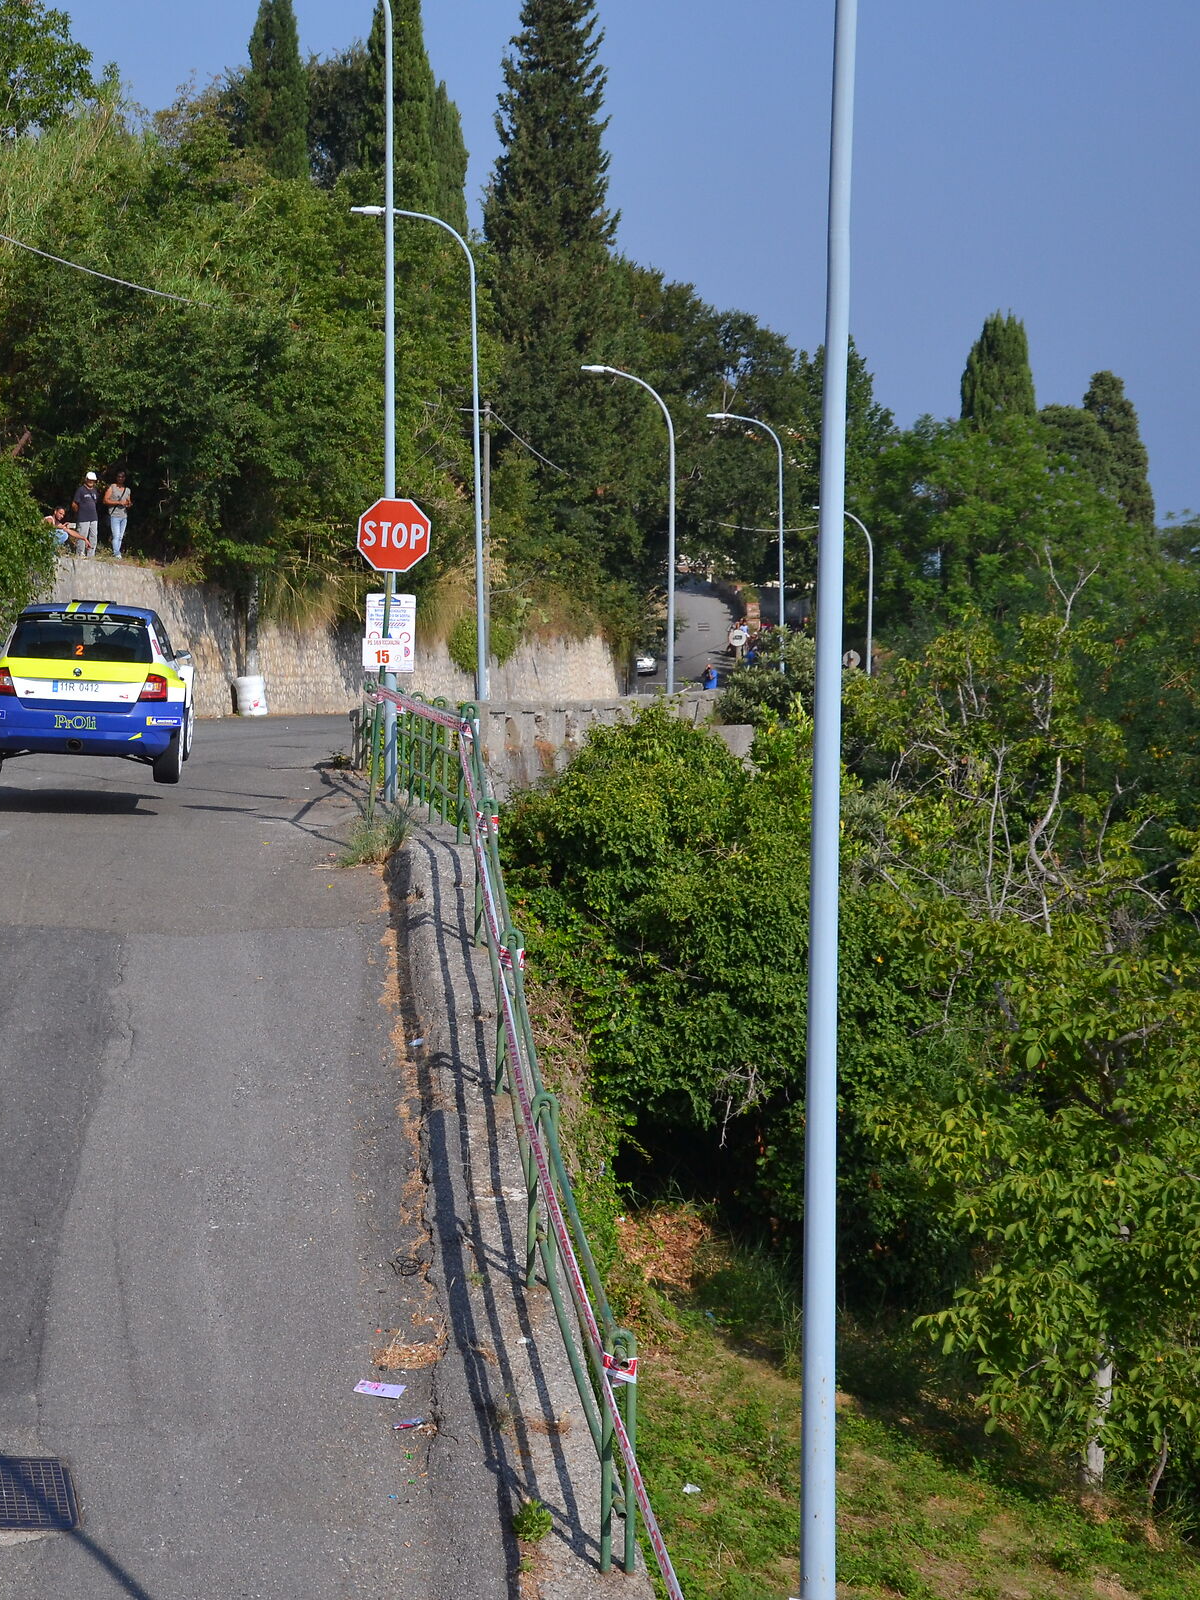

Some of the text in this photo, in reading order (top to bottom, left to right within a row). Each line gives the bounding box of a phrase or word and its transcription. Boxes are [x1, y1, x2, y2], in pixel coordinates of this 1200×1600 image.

[363, 520, 425, 550] STOP
[49, 612, 112, 621] ŠKODA
[75, 644, 84, 656] 2
[375, 650, 389, 663] 15
[79, 683, 99, 692] 0412
